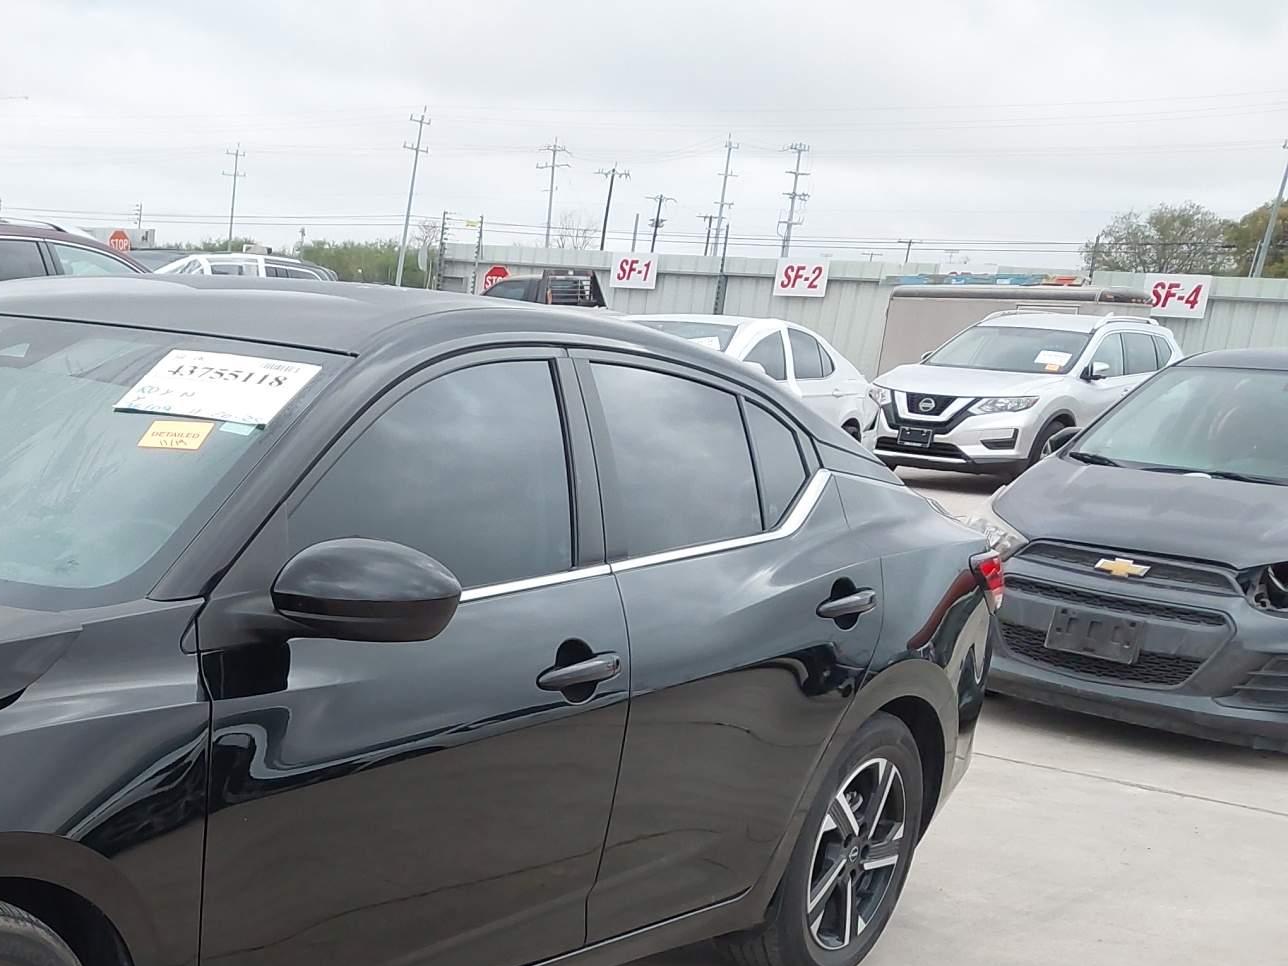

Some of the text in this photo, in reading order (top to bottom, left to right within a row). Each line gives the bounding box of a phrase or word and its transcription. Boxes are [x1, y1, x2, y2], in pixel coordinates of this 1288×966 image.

[110, 238, 129, 250] STOP
[616, 258, 652, 282] SF-1
[780, 264, 824, 290] SF-2
[1151, 281, 1203, 310] SF-4
[167, 364, 289, 388] 43755118
